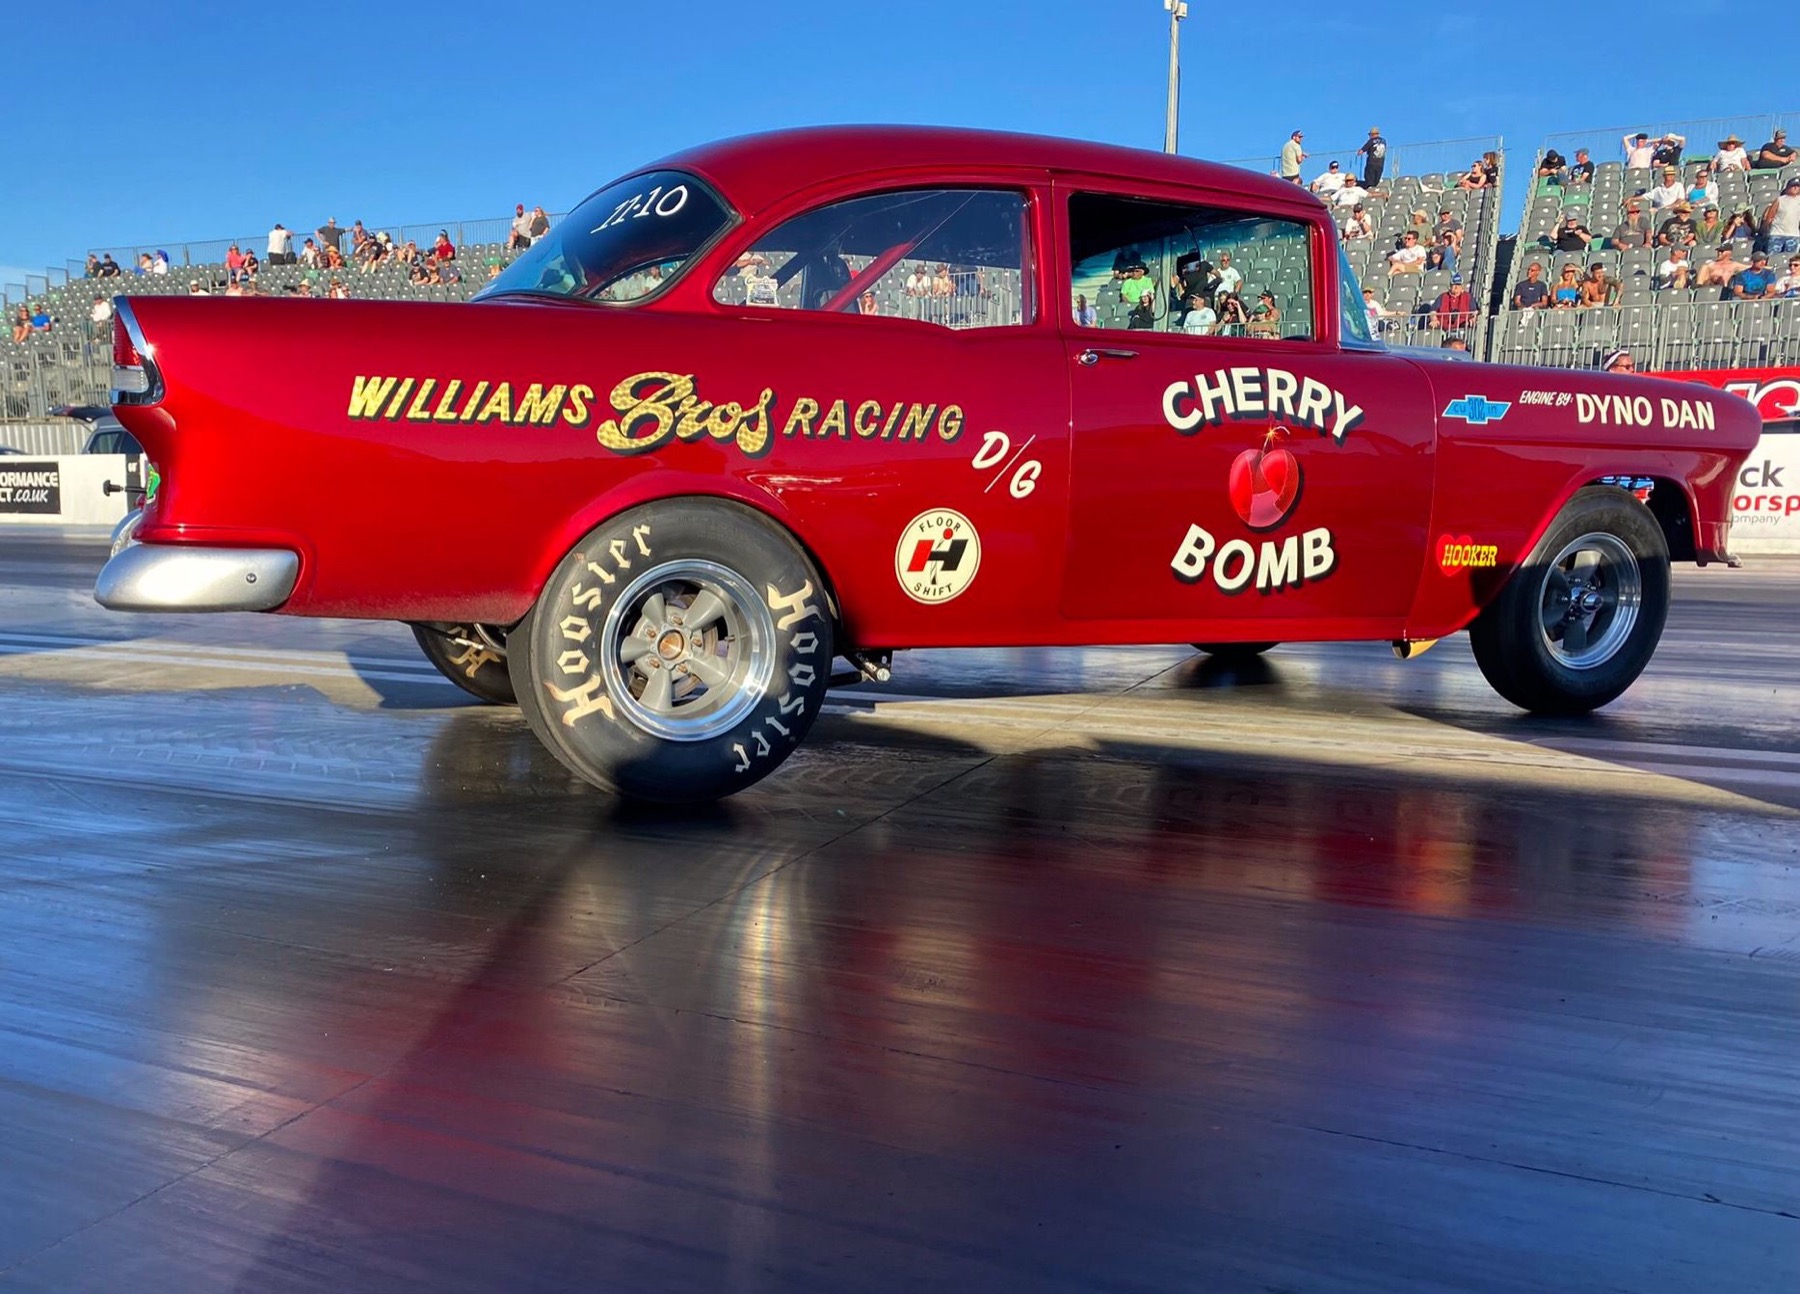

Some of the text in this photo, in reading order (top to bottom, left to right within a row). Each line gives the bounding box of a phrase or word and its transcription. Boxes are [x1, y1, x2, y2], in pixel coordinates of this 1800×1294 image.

[347, 371, 963, 454] WILLIAMS Bros RACING
[1162, 367, 1363, 438] CHERRY
[1468, 398, 1485, 420] 302
[1519, 390, 1557, 406] ENGINE
[1576, 393, 1653, 427] DYNO
[1662, 399, 1715, 430] DAN
[971, 431, 1042, 499] D/G
[919, 516, 961, 533] FLOOR
[1170, 523, 1335, 590] BOMB
[1441, 544, 1498, 567] HOOKER
[913, 582, 953, 597] SHIFT
[543, 523, 652, 728] Hoosier
[733, 579, 825, 773] Hoosier
